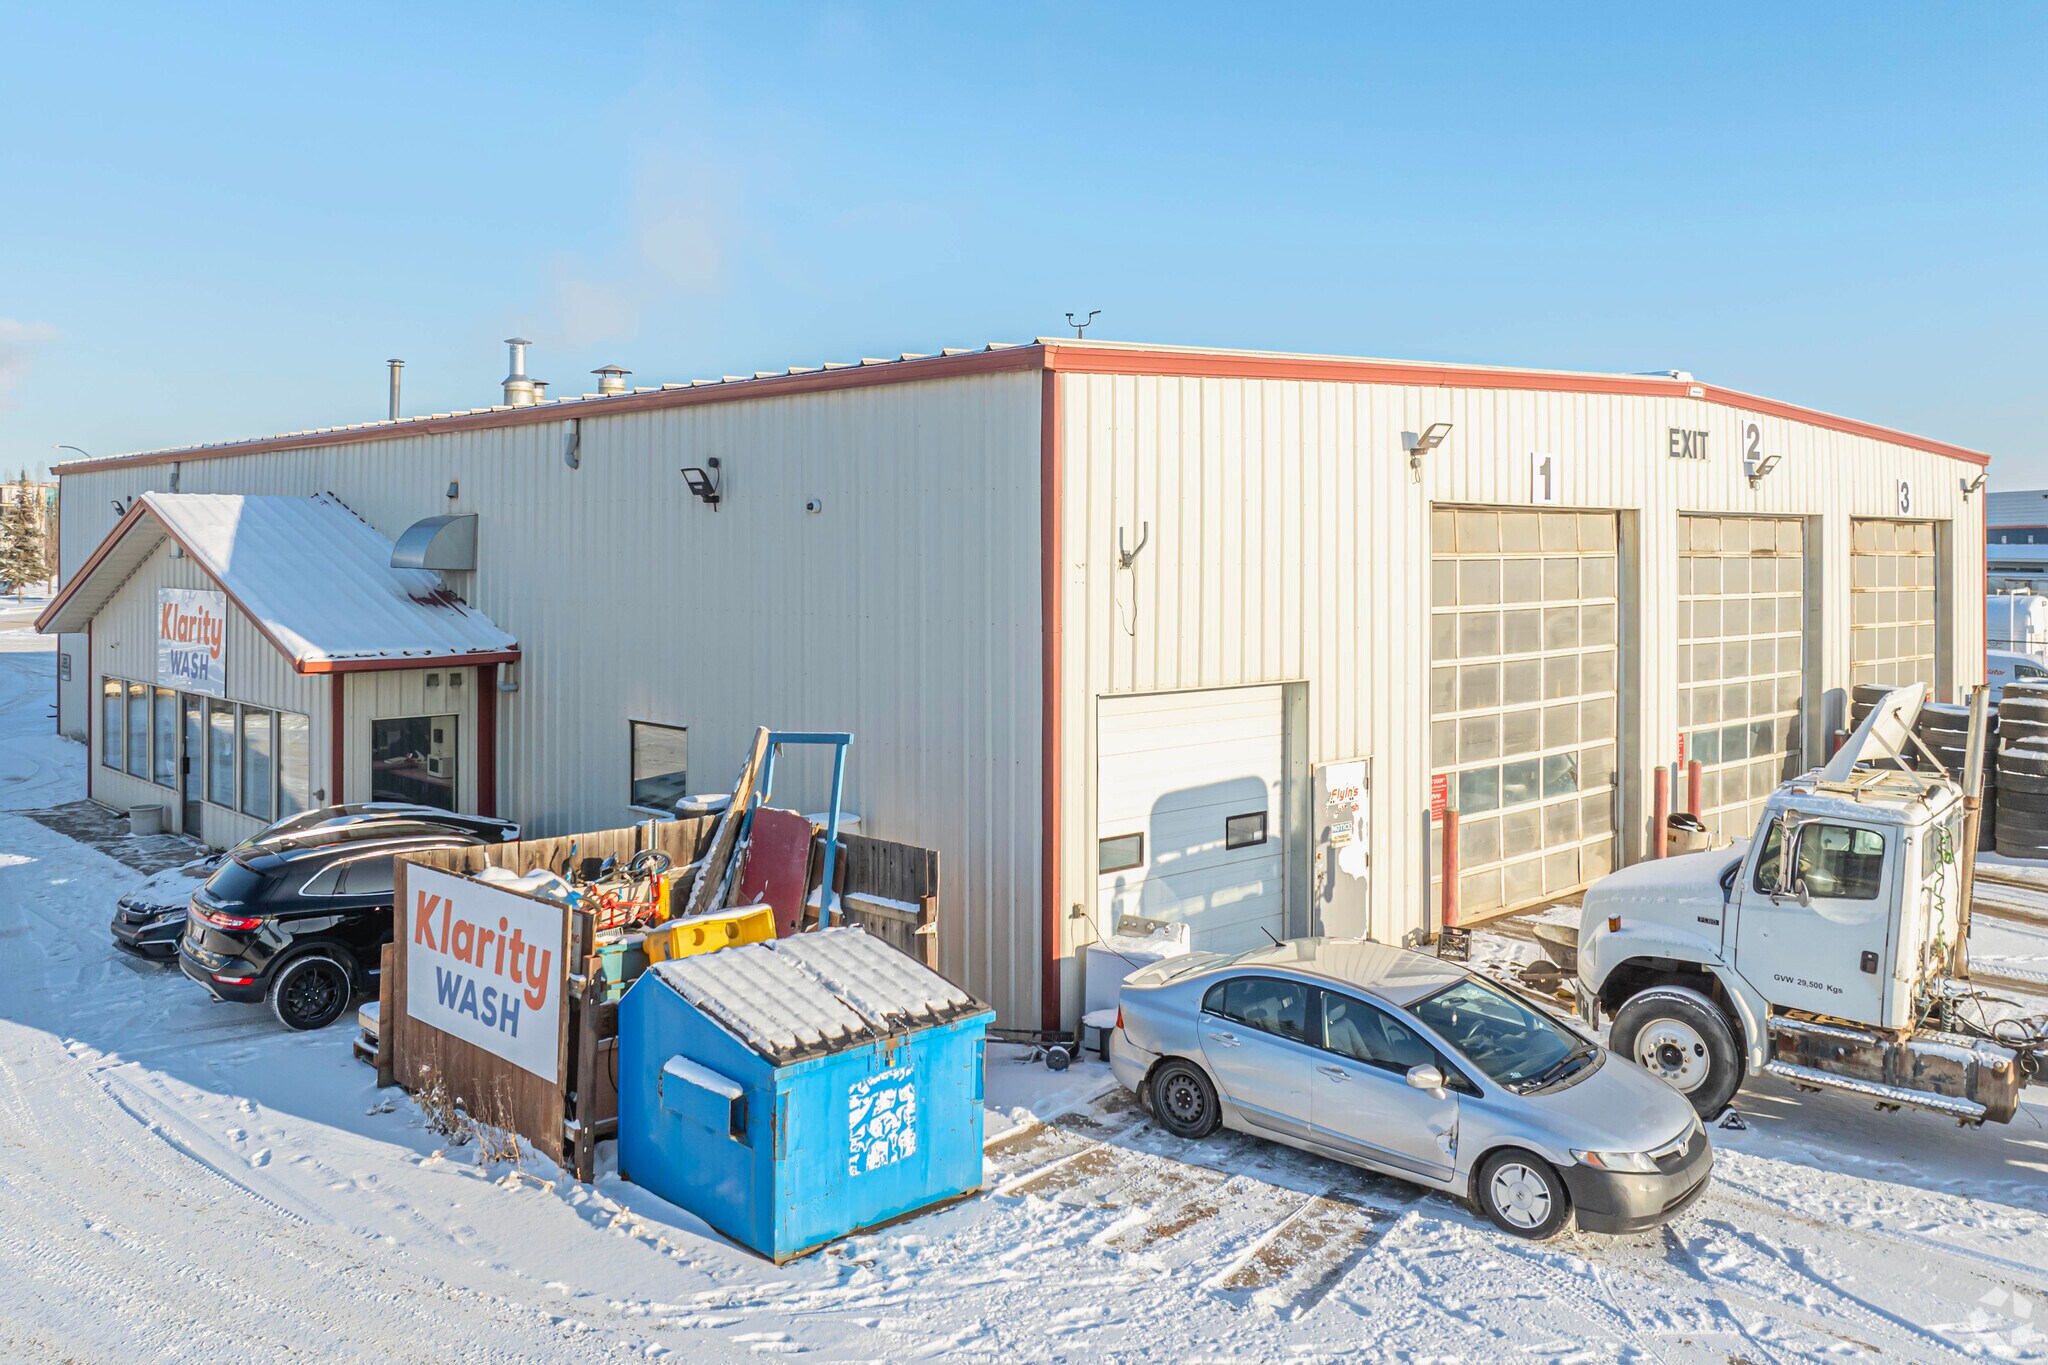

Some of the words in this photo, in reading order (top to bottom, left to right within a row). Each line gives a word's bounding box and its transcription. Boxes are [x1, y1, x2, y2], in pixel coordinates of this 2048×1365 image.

[1669, 428, 1709, 460] EXIT
[1747, 423, 1760, 461] 2
[1539, 457, 1551, 500] 1
[1900, 481, 1910, 514] 3
[161, 602, 223, 660] Klarity
[170, 649, 210, 681] WASH
[414, 889, 552, 1012] Klarity
[435, 965, 521, 1039] WASH
[1773, 973, 1794, 983] GVW
[1826, 984, 1843, 995] Kgs
